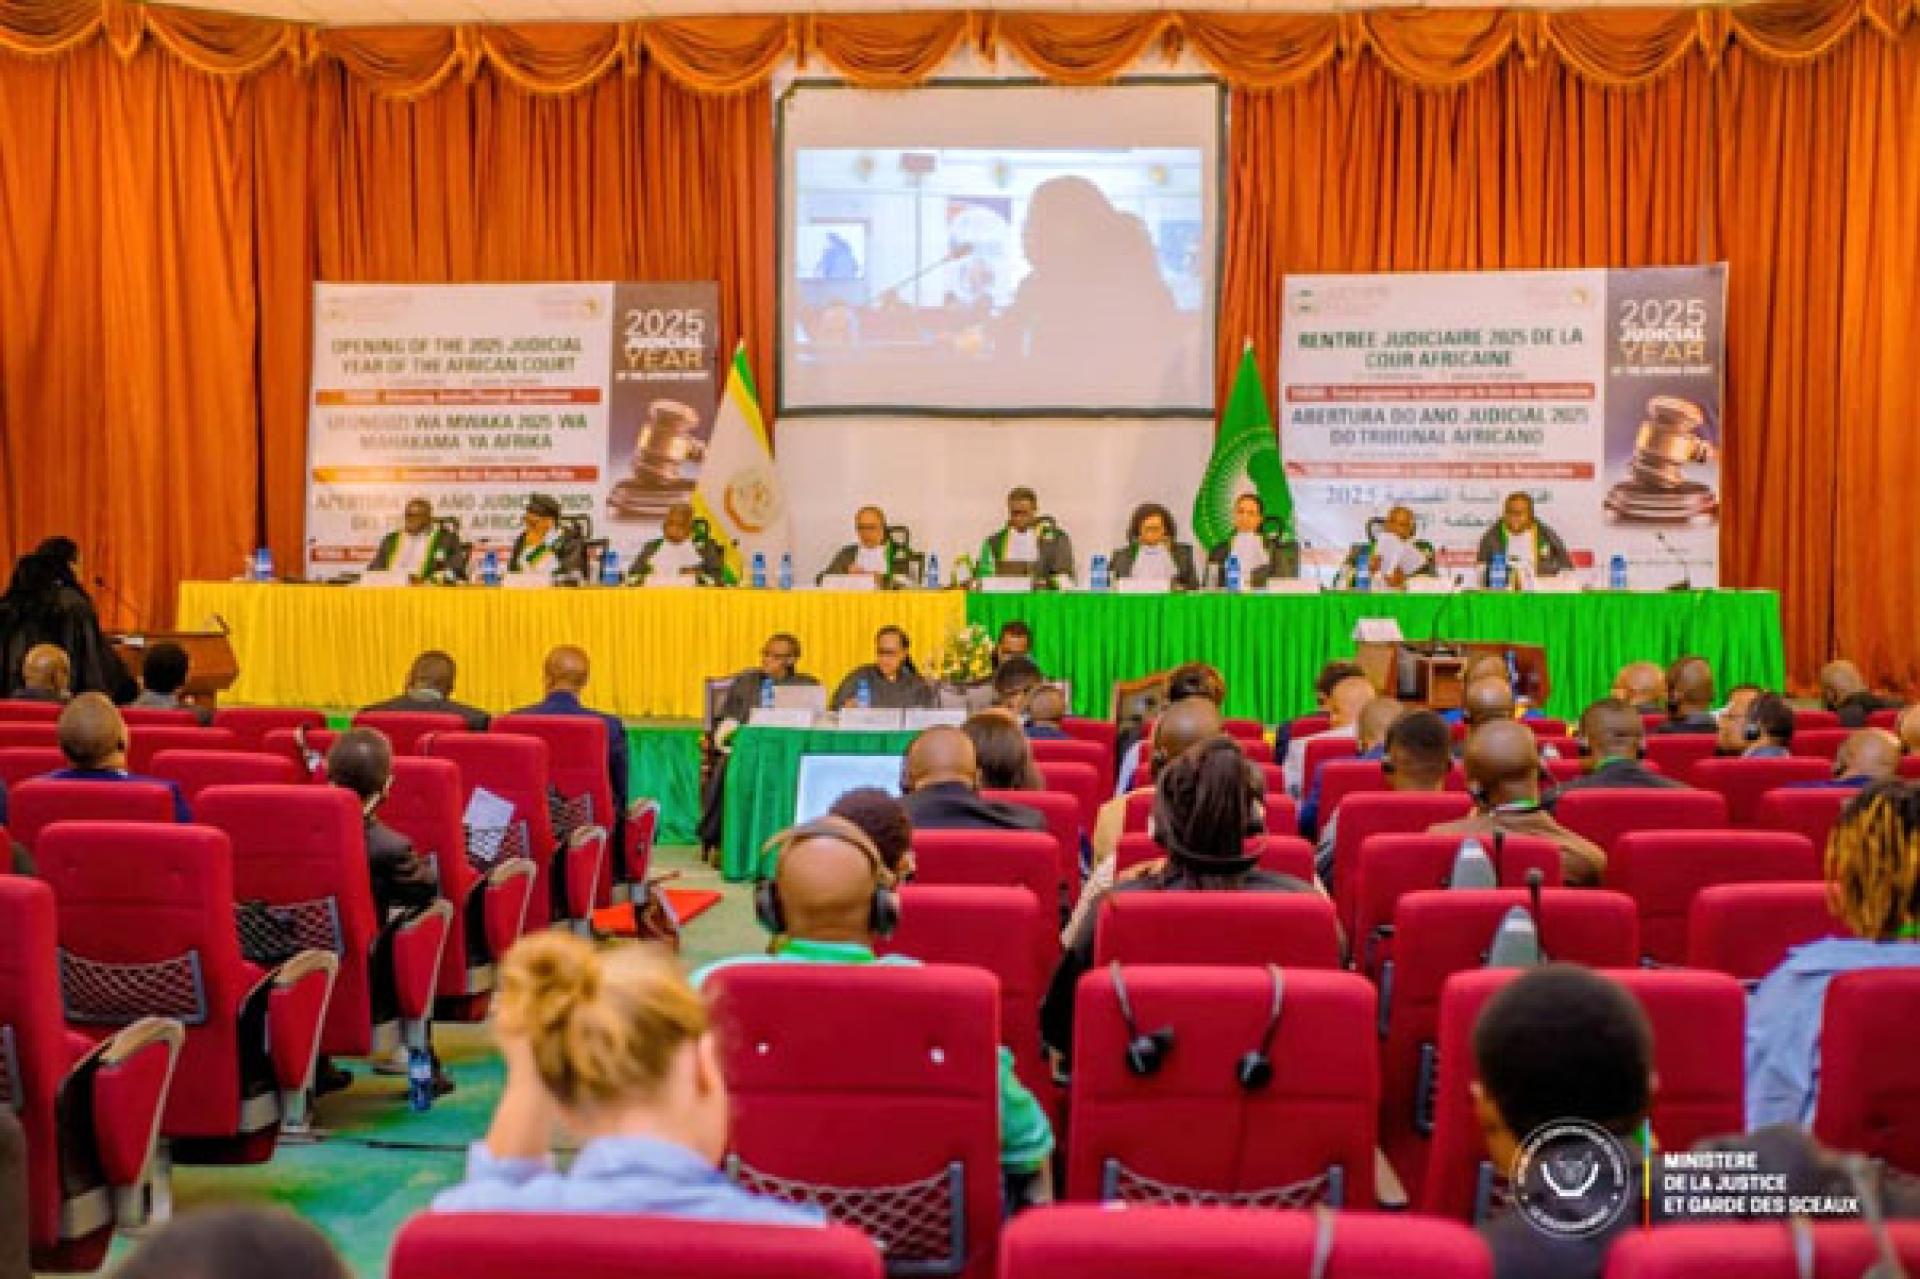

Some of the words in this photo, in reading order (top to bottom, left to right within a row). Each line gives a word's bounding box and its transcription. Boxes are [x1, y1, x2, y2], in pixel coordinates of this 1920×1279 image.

[1619, 298, 1707, 327] 2025
[624, 308, 706, 336] 2025
[331, 337, 405, 354] OPENING
[408, 337, 428, 353] OF
[435, 337, 463, 352] THE
[469, 337, 504, 352] 2025
[508, 336, 581, 352] JUDICIAL
[1383, 329, 1481, 347] JUDICIAIRE
[1488, 328, 1526, 346] 2025
[1531, 328, 1555, 345] DE
[1560, 327, 1583, 345] LA
[623, 347, 702, 369] YEAR
[1364, 350, 1415, 368] COUR
[1419, 350, 1511, 367] AFRICAINE
[1619, 341, 1705, 364] YEAR
[342, 357, 383, 374] YEAR
[386, 357, 406, 373] OF
[412, 357, 440, 373] THE
[446, 356, 518, 372] AFRICAN
[522, 356, 576, 372] COURT
[414, 414, 440, 429] WA
[446, 414, 513, 429] MWAKA
[517, 414, 551, 429] 2025
[558, 414, 587, 429] WA
[1291, 408, 1386, 424] ABERTURA
[1390, 408, 1416, 424] DO
[1419, 408, 1458, 424] ANO
[1464, 408, 1544, 424] JUDICIAL
[1552, 408, 1589, 424] 2025
[468, 434, 490, 449] YA
[494, 434, 552, 449] AFRIKA
[1330, 429, 1355, 446] DO
[1361, 429, 1445, 445] TRIBUNAL
[1453, 428, 1544, 445] AFRICANO
